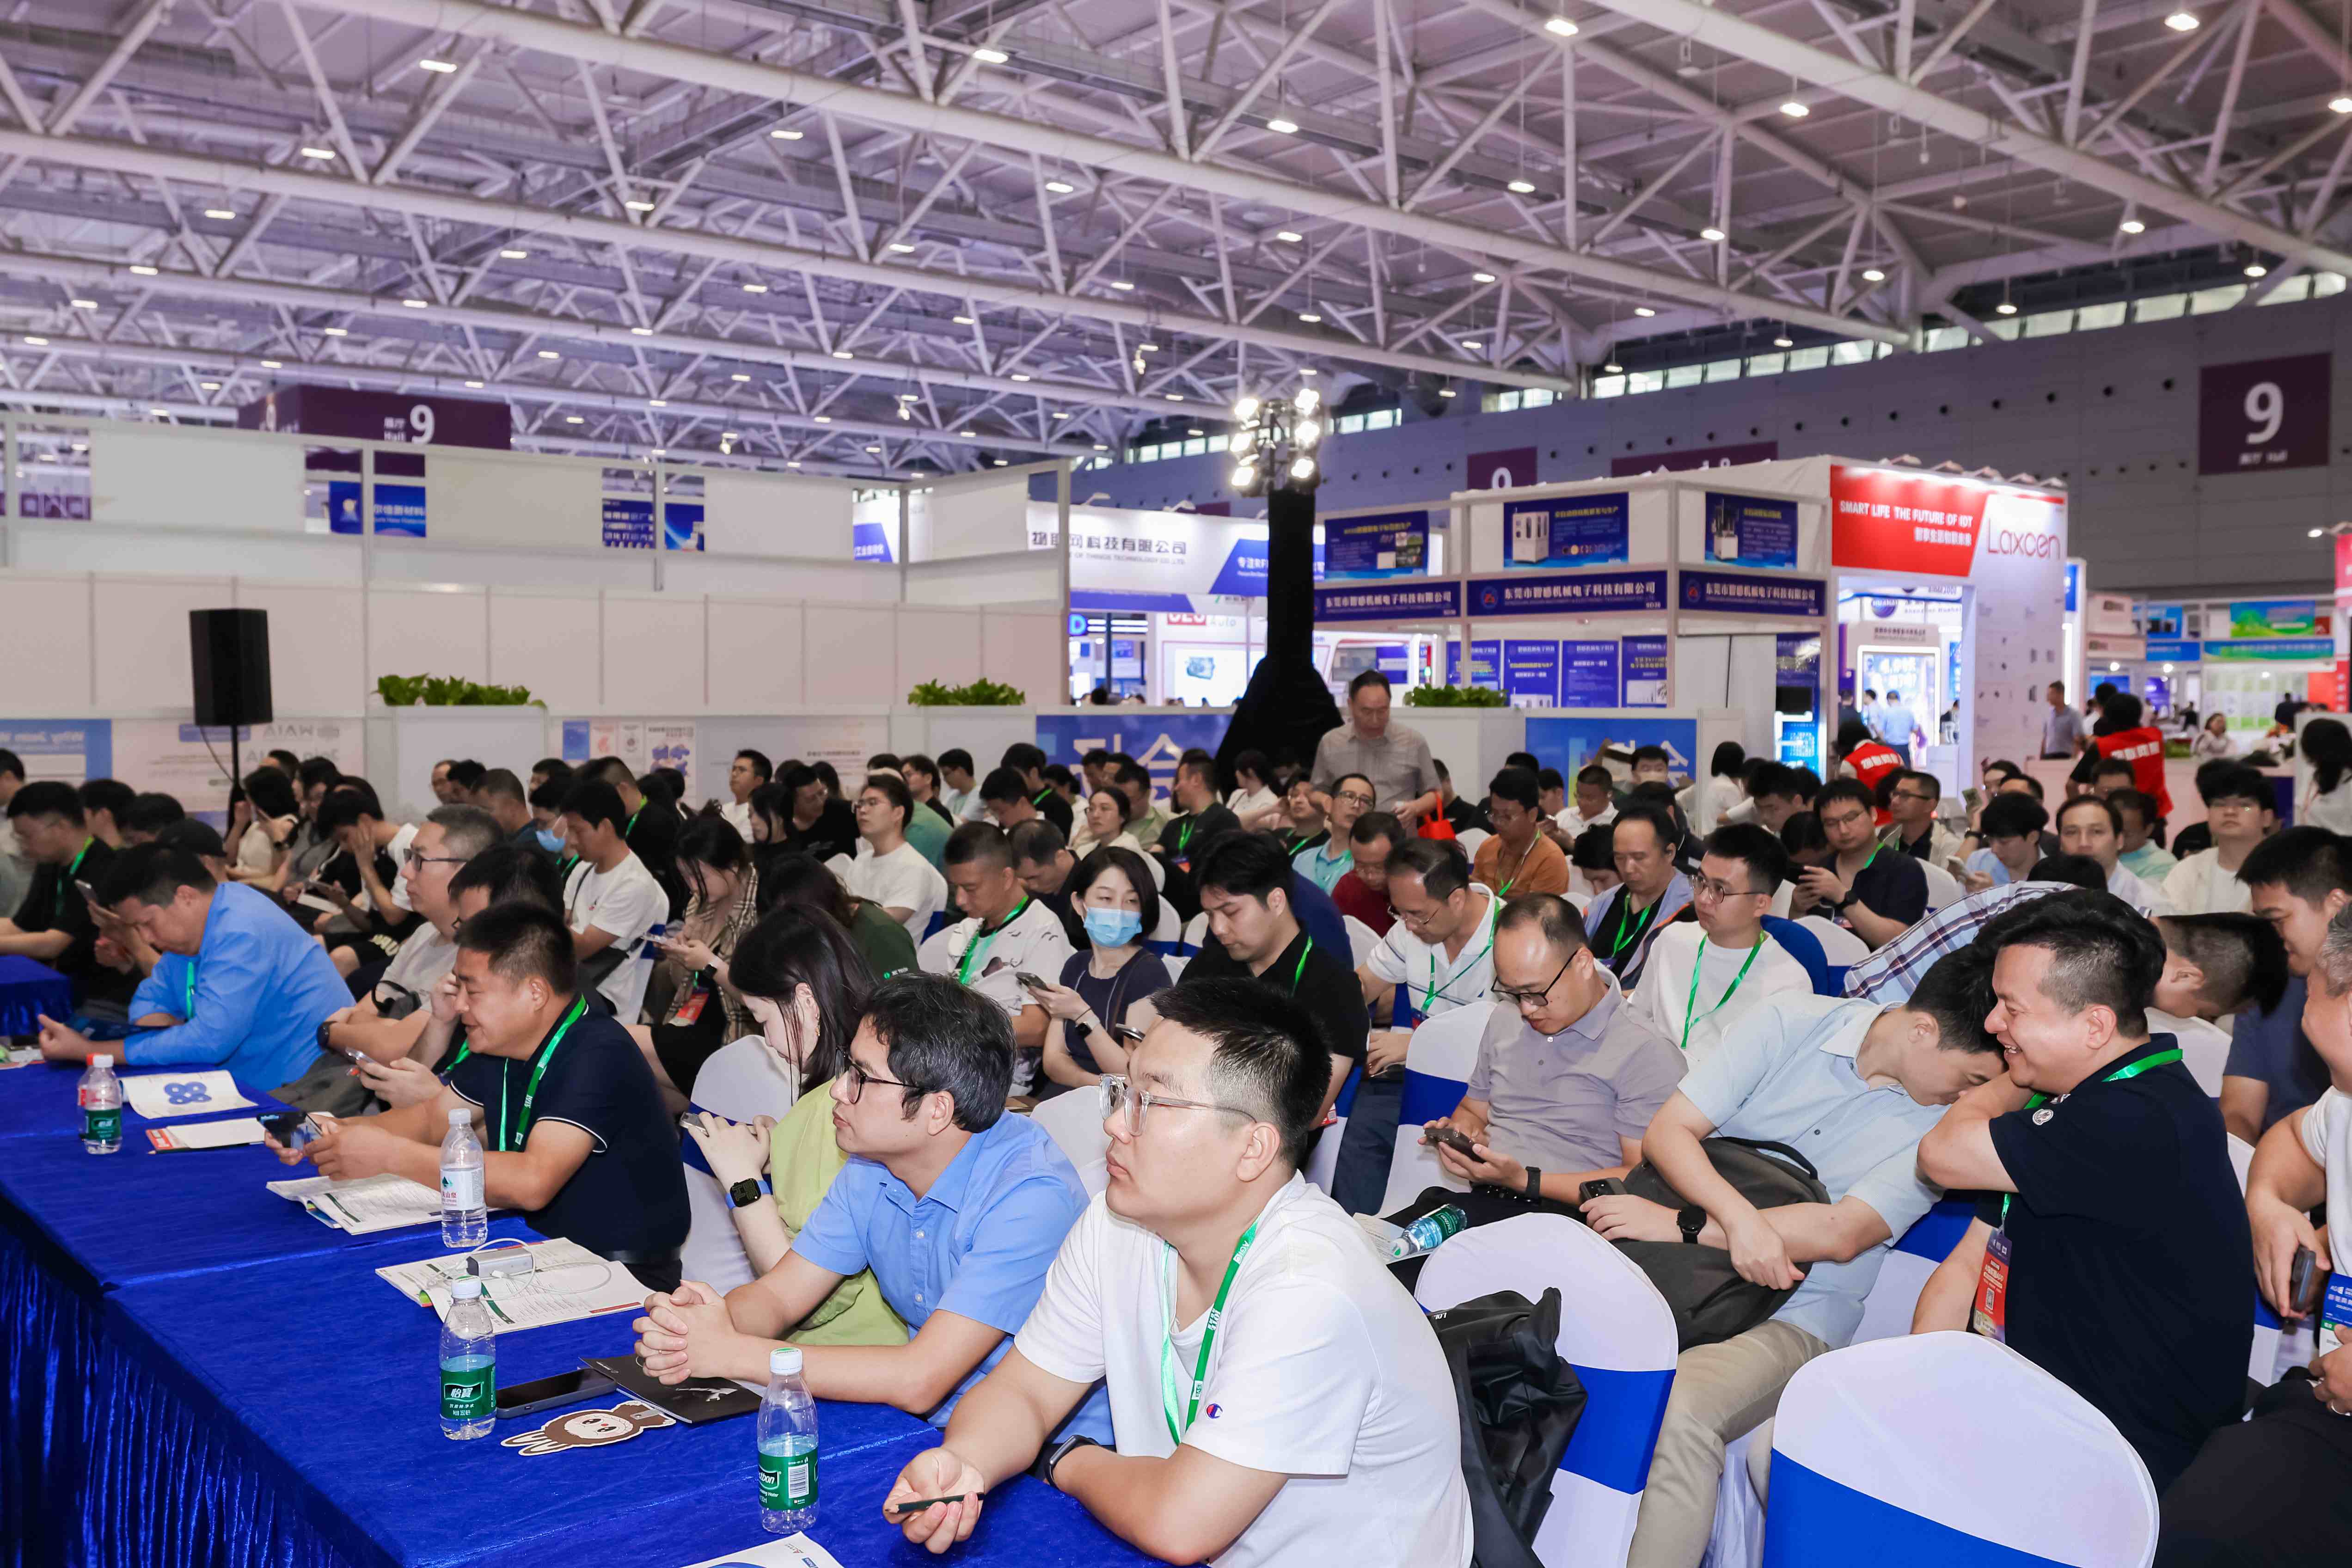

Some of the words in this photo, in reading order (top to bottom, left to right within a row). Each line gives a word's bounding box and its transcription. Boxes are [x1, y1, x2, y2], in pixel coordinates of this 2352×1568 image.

[2244, 382, 2284, 444] 9
[384, 417, 405, 429] 展厅
[410, 404, 435, 444] 9
[384, 430, 406, 441] Hall
[2266, 450, 2288, 463] Hall
[1839, 501, 1870, 515] SMART
[1872, 504, 1890, 518] LIFE
[1894, 506, 1911, 521] THE
[1912, 509, 1945, 525] FUTURE
[1947, 514, 1957, 526] OF
[1959, 515, 1973, 527] IOT
[1988, 518, 2061, 559] Laxcen
[451, 1387, 473, 1398] 怡寶
